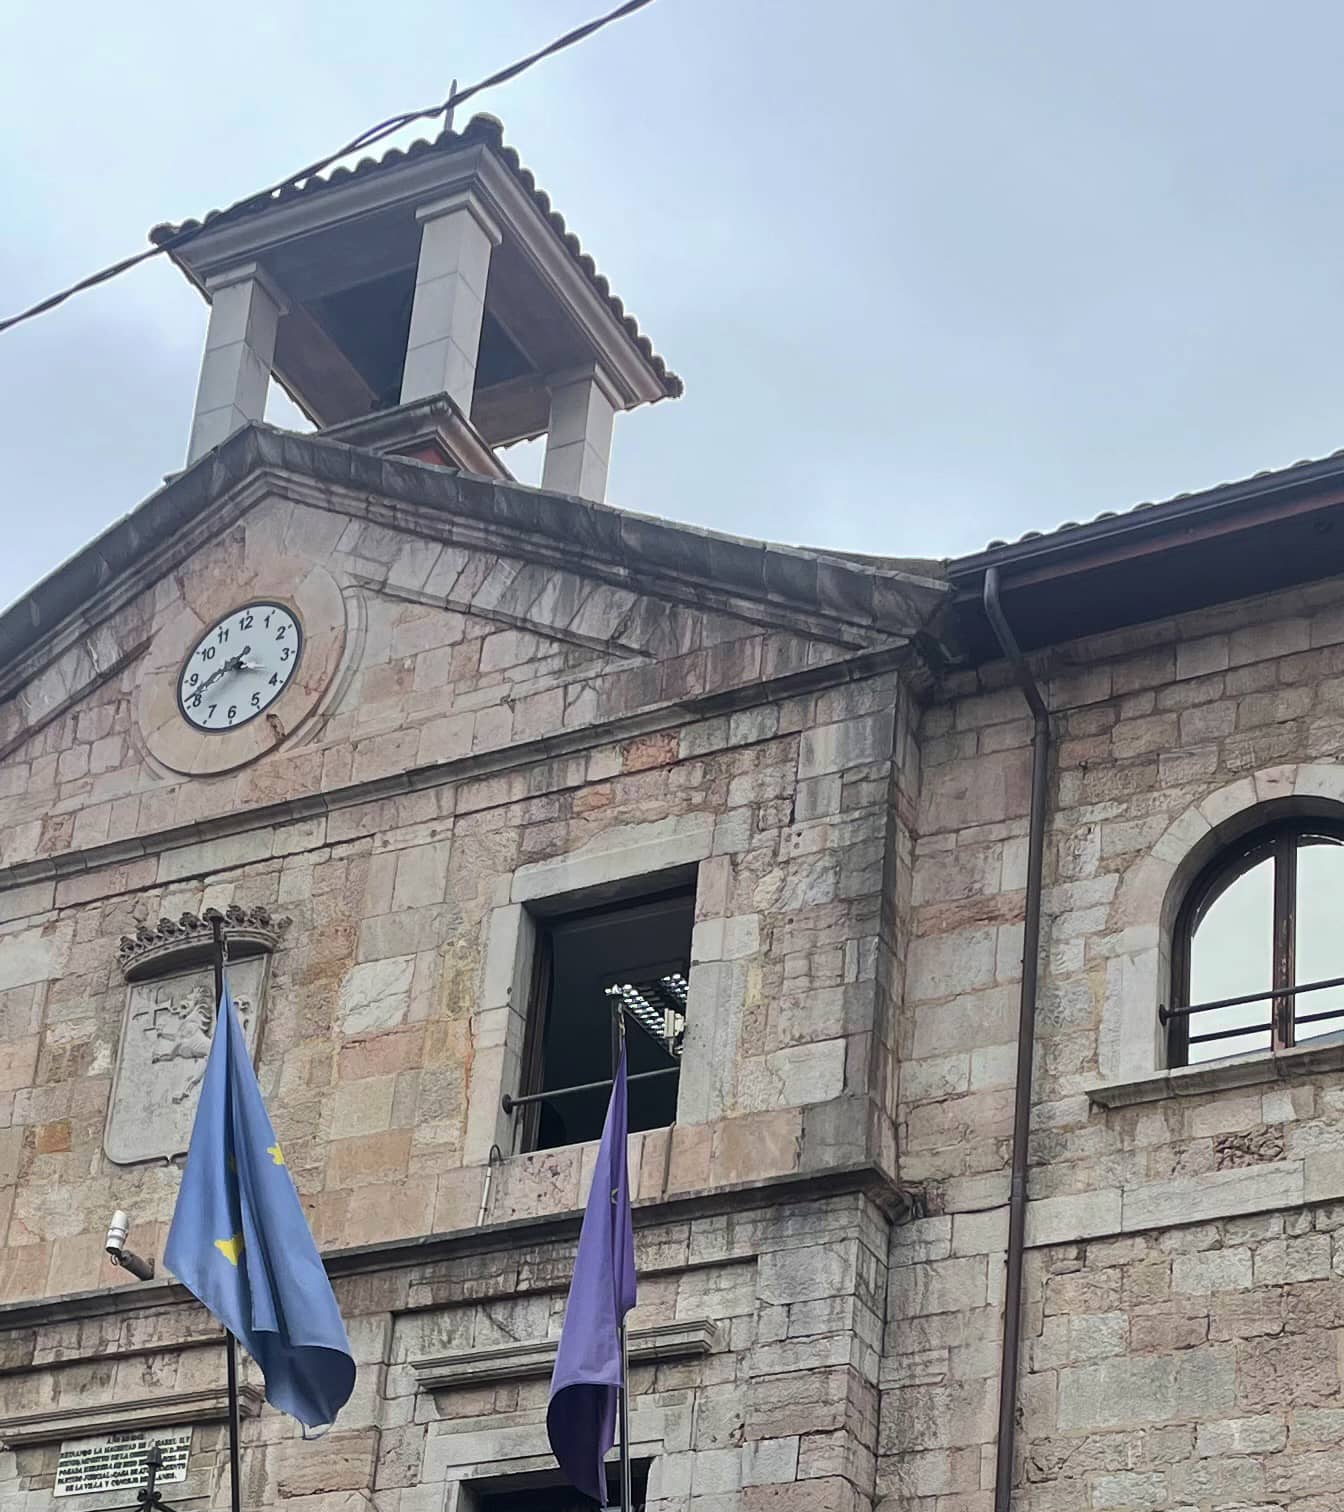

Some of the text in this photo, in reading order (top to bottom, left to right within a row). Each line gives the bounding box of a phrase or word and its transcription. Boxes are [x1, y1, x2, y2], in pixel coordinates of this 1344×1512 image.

[239, 615, 254, 631] 12
[264, 615, 271, 629] 1
[218, 628, 230, 644] 11
[276, 626, 286, 640] 2
[201, 646, 216, 661] 10
[280, 648, 290, 661] 3
[189, 673, 199, 686] 9
[268, 672, 279, 686] 4
[192, 691, 202, 707] 8
[251, 692, 261, 706] 5
[208, 704, 218, 719] 7
[227, 705, 237, 719] 6
